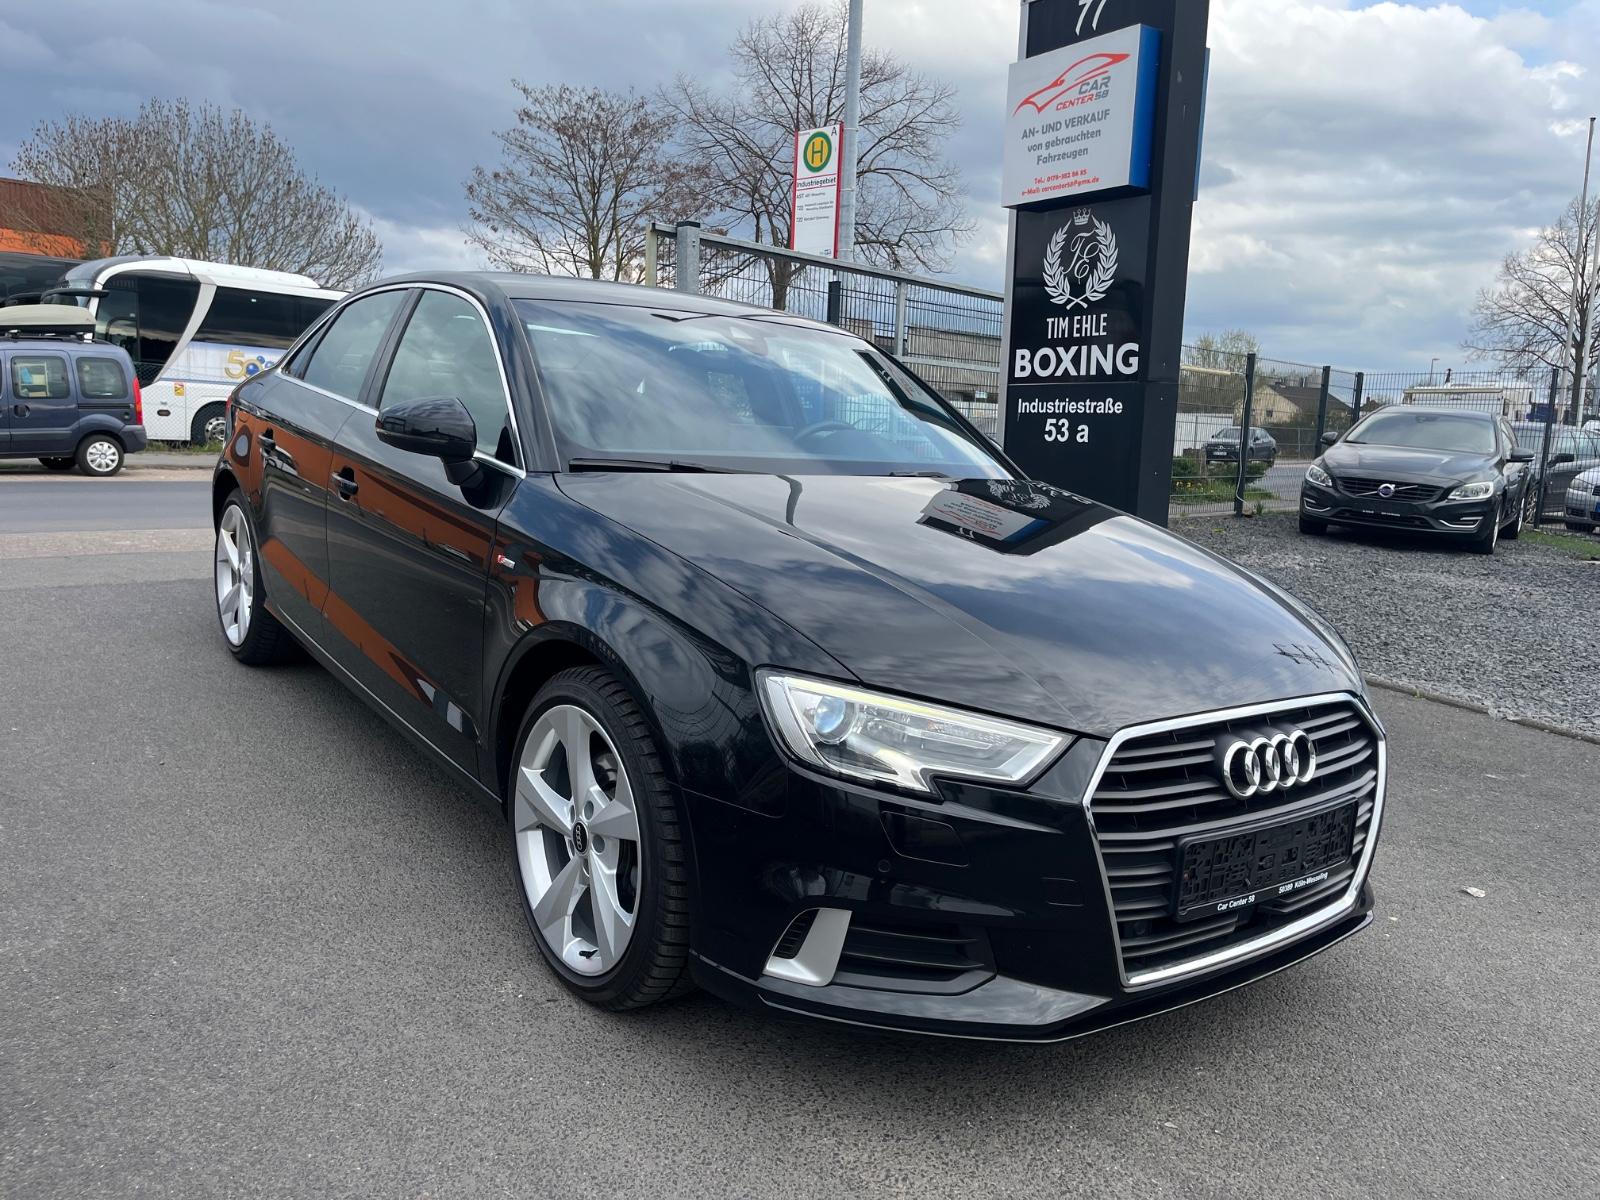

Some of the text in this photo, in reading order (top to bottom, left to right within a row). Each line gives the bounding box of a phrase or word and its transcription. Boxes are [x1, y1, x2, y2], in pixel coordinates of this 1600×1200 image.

[1079, 76, 1111, 95] CAR
[831, 126, 838, 137] A
[1021, 109, 1111, 140] AN- UND VERKAUF
[1027, 129, 1101, 152] von gebrauchten
[811, 140, 824, 164] H
[1036, 148, 1089, 165] Fahrzeugen
[797, 177, 836, 188] Industriegebiet
[1046, 313, 1108, 340] TIM EHLE
[1014, 342, 1140, 378] BOXING
[1017, 398, 1123, 414] Industriestraße
[1044, 419, 1089, 443] 53 a
[1217, 894, 1256, 911] Car Center 58
